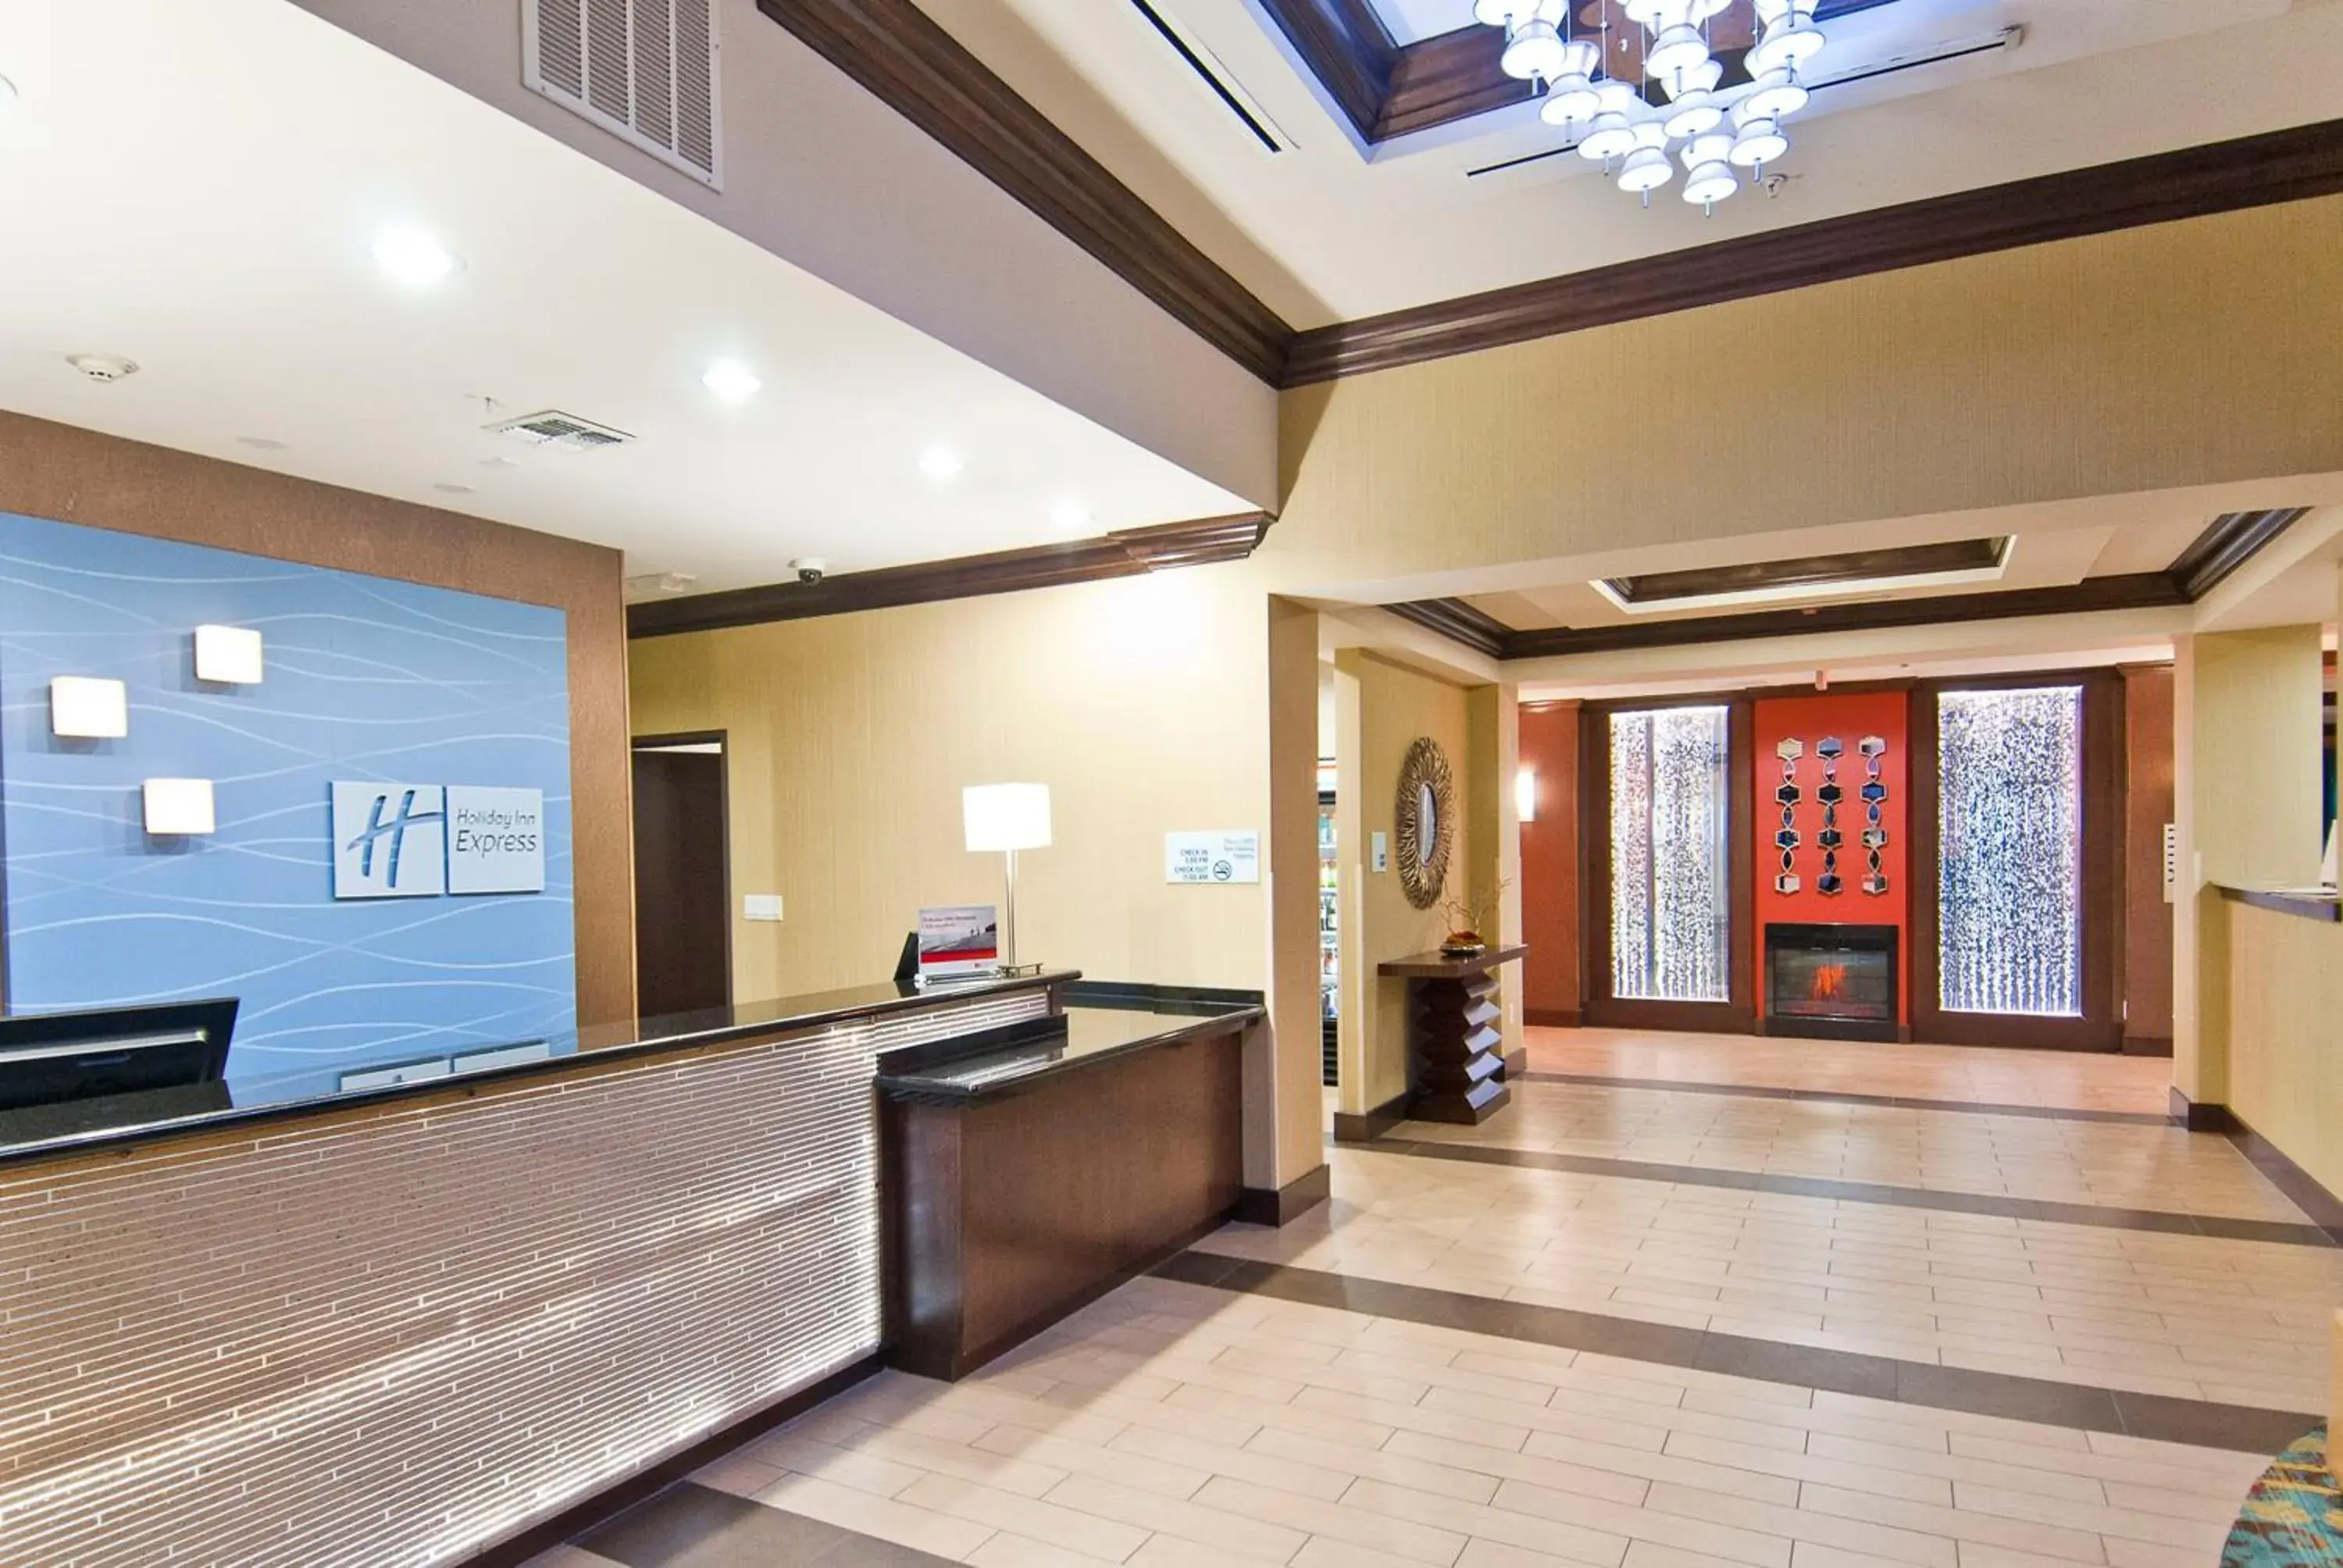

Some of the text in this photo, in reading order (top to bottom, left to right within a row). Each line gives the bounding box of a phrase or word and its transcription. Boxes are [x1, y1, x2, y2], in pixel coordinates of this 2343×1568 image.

[456, 808, 536, 829] Holiday Inn
[455, 829, 537, 858] Express
